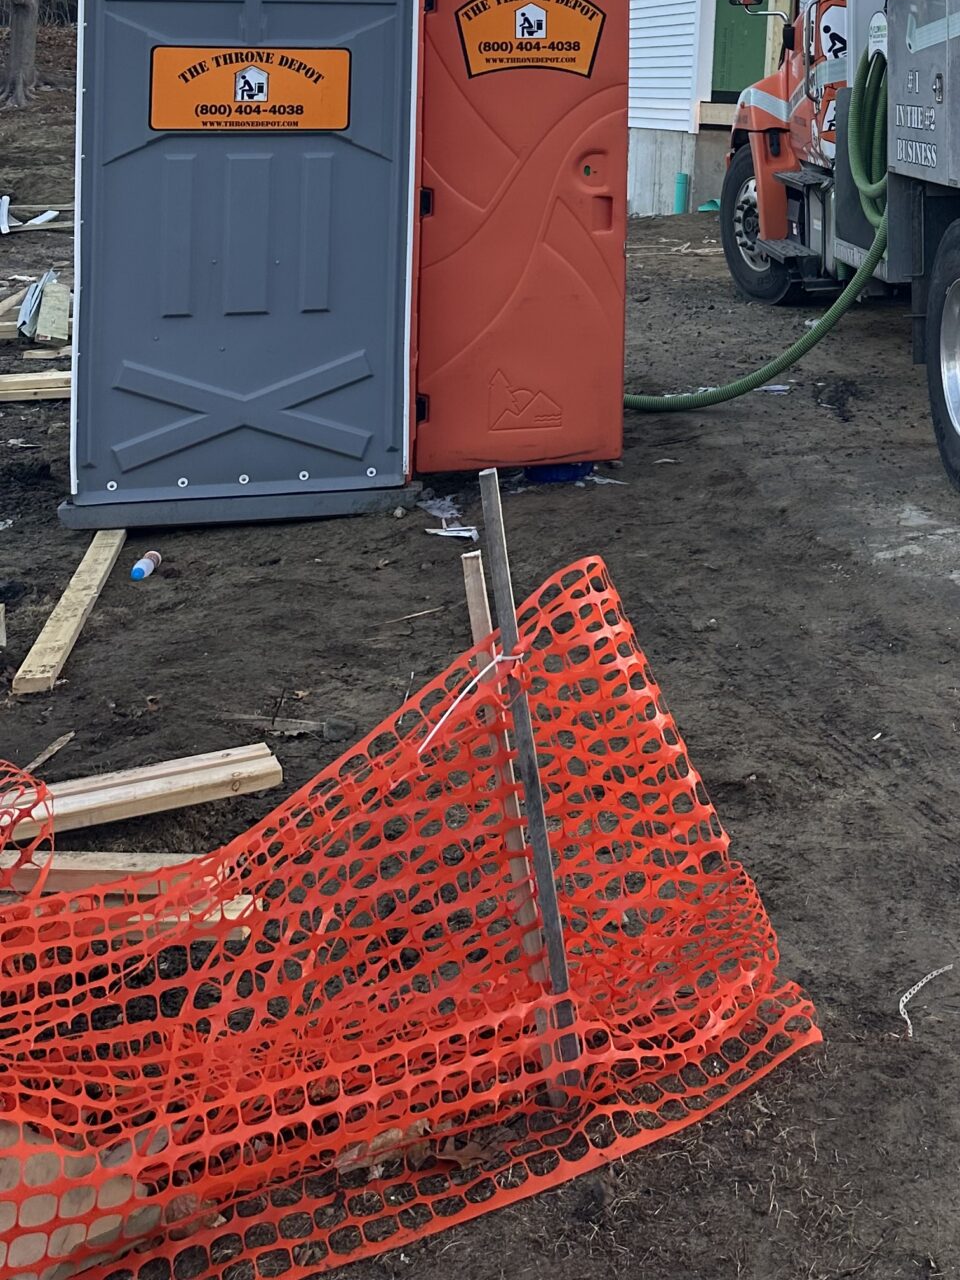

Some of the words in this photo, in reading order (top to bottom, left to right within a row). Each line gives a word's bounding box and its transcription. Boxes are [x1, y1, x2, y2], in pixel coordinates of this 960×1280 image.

[462, 0, 491, 22] THE
[478, 41, 513, 54] (800)
[516, 41, 581, 52] 404-4038
[178, 60, 209, 84] THE
[212, 51, 274, 68] THRONE
[278, 55, 325, 85] DEPOT
[907, 70, 920, 94] #1
[194, 104, 232, 117] (800)
[235, 104, 304, 116] 404-4038
[896, 104, 905, 126] IN
[906, 105, 923, 129] THE
[925, 107, 936, 131] #2
[897, 138, 937, 168] BUSINESS
